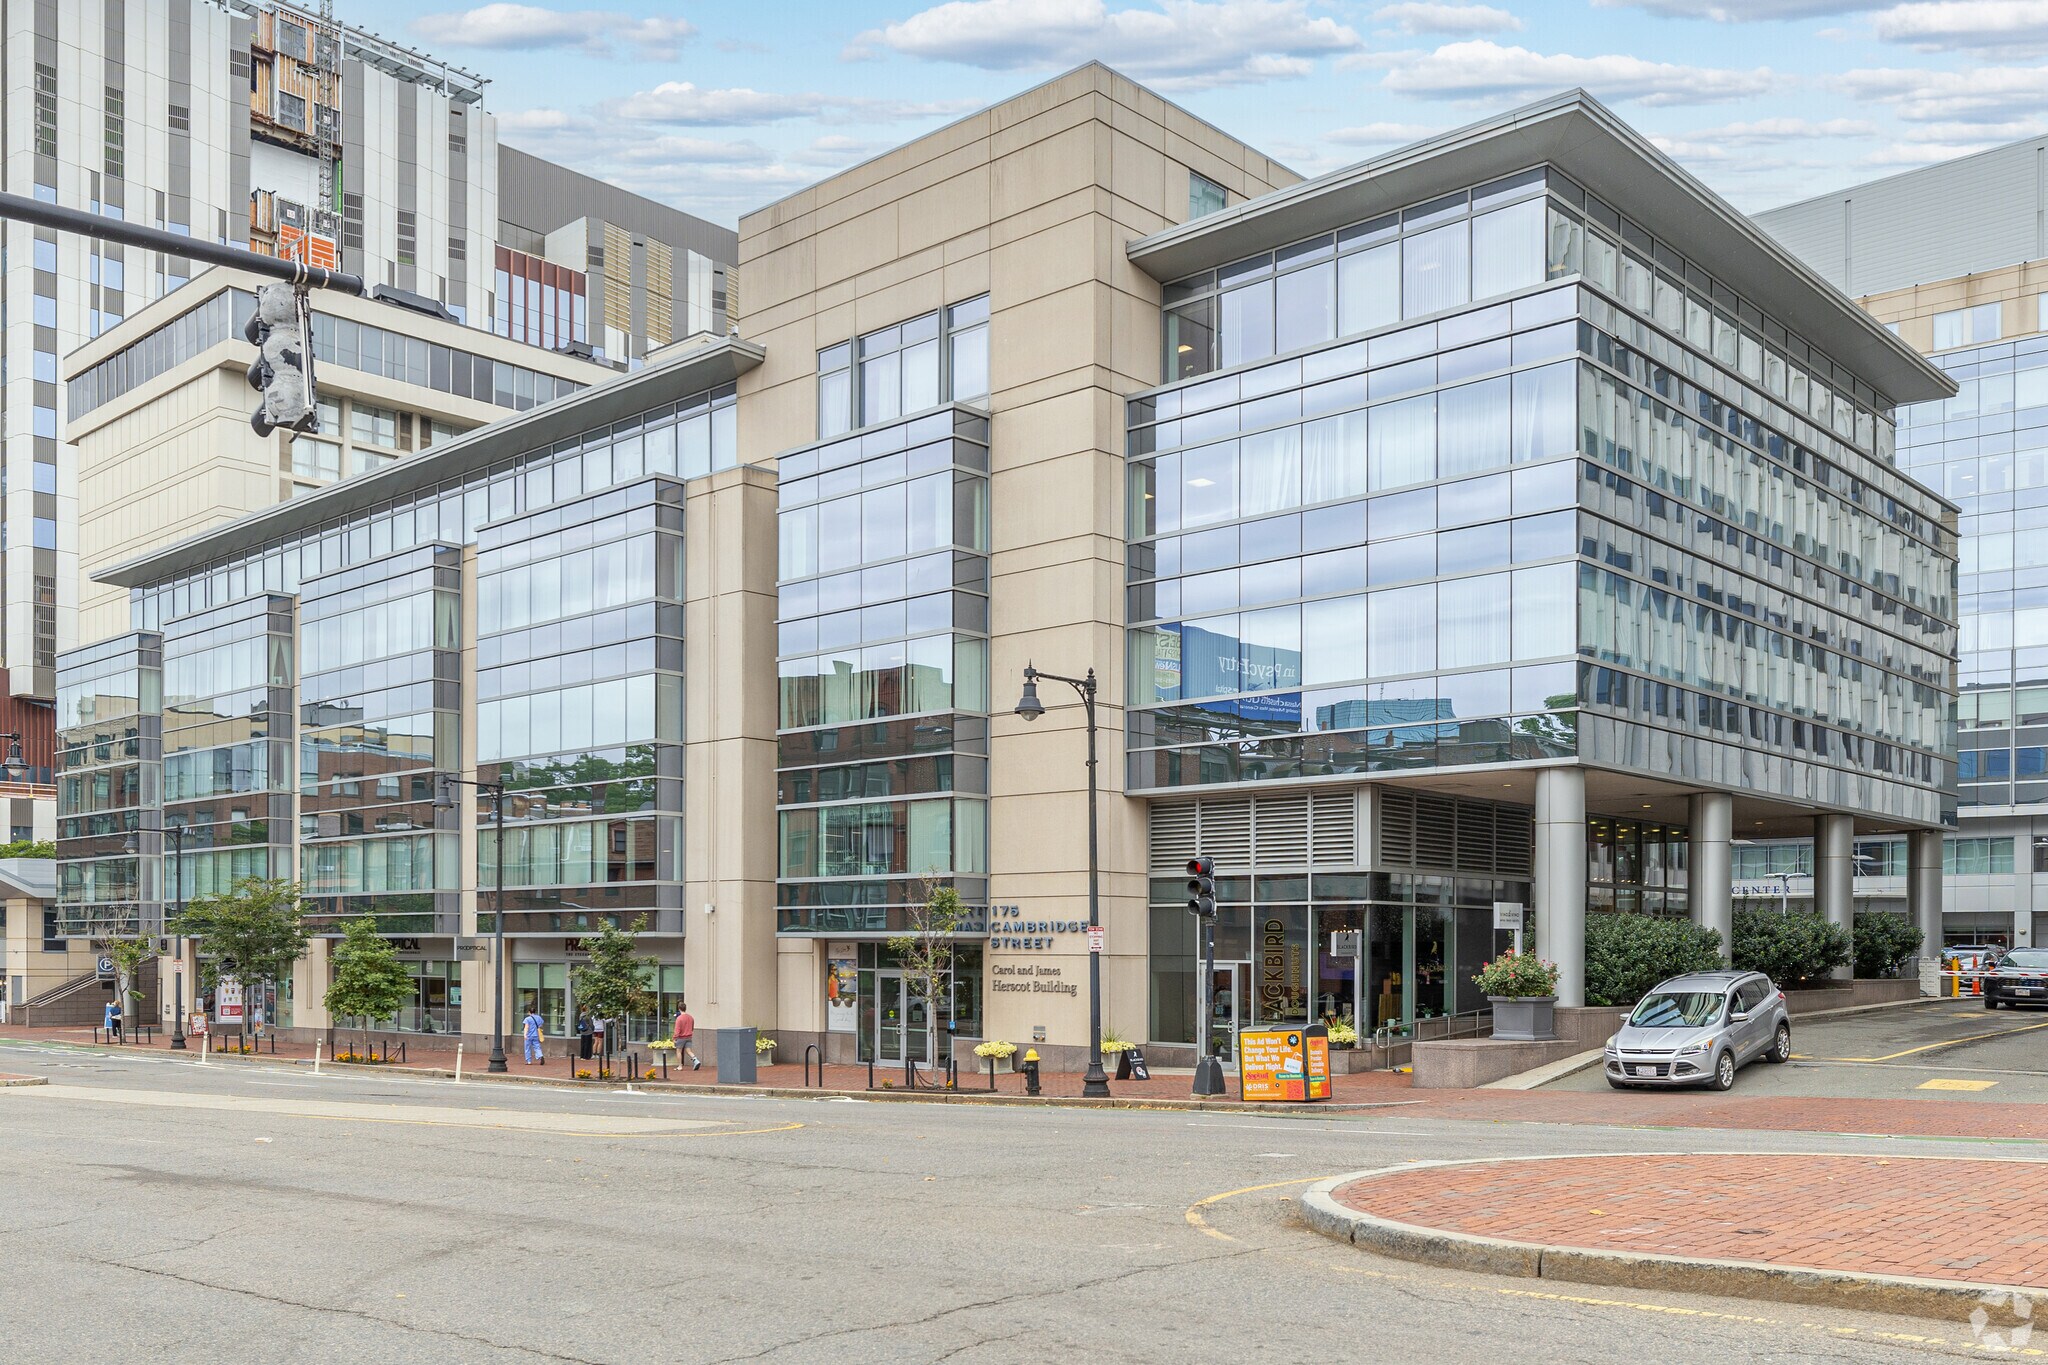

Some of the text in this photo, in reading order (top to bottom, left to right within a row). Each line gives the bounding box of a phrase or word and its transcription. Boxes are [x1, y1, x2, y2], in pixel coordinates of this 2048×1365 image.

[1731, 886, 1791, 894] CENTER
[991, 905, 1019, 917] 175
[990, 921, 1090, 933] CAMBRIDGE
[990, 938, 1054, 949] STREET
[992, 965, 1061, 977] Carol and James
[1263, 919, 1285, 1022] LACKBIRD
[1291, 944, 1300, 1015] DOUGHNUTS
[992, 980, 1077, 997] Herscot Building
